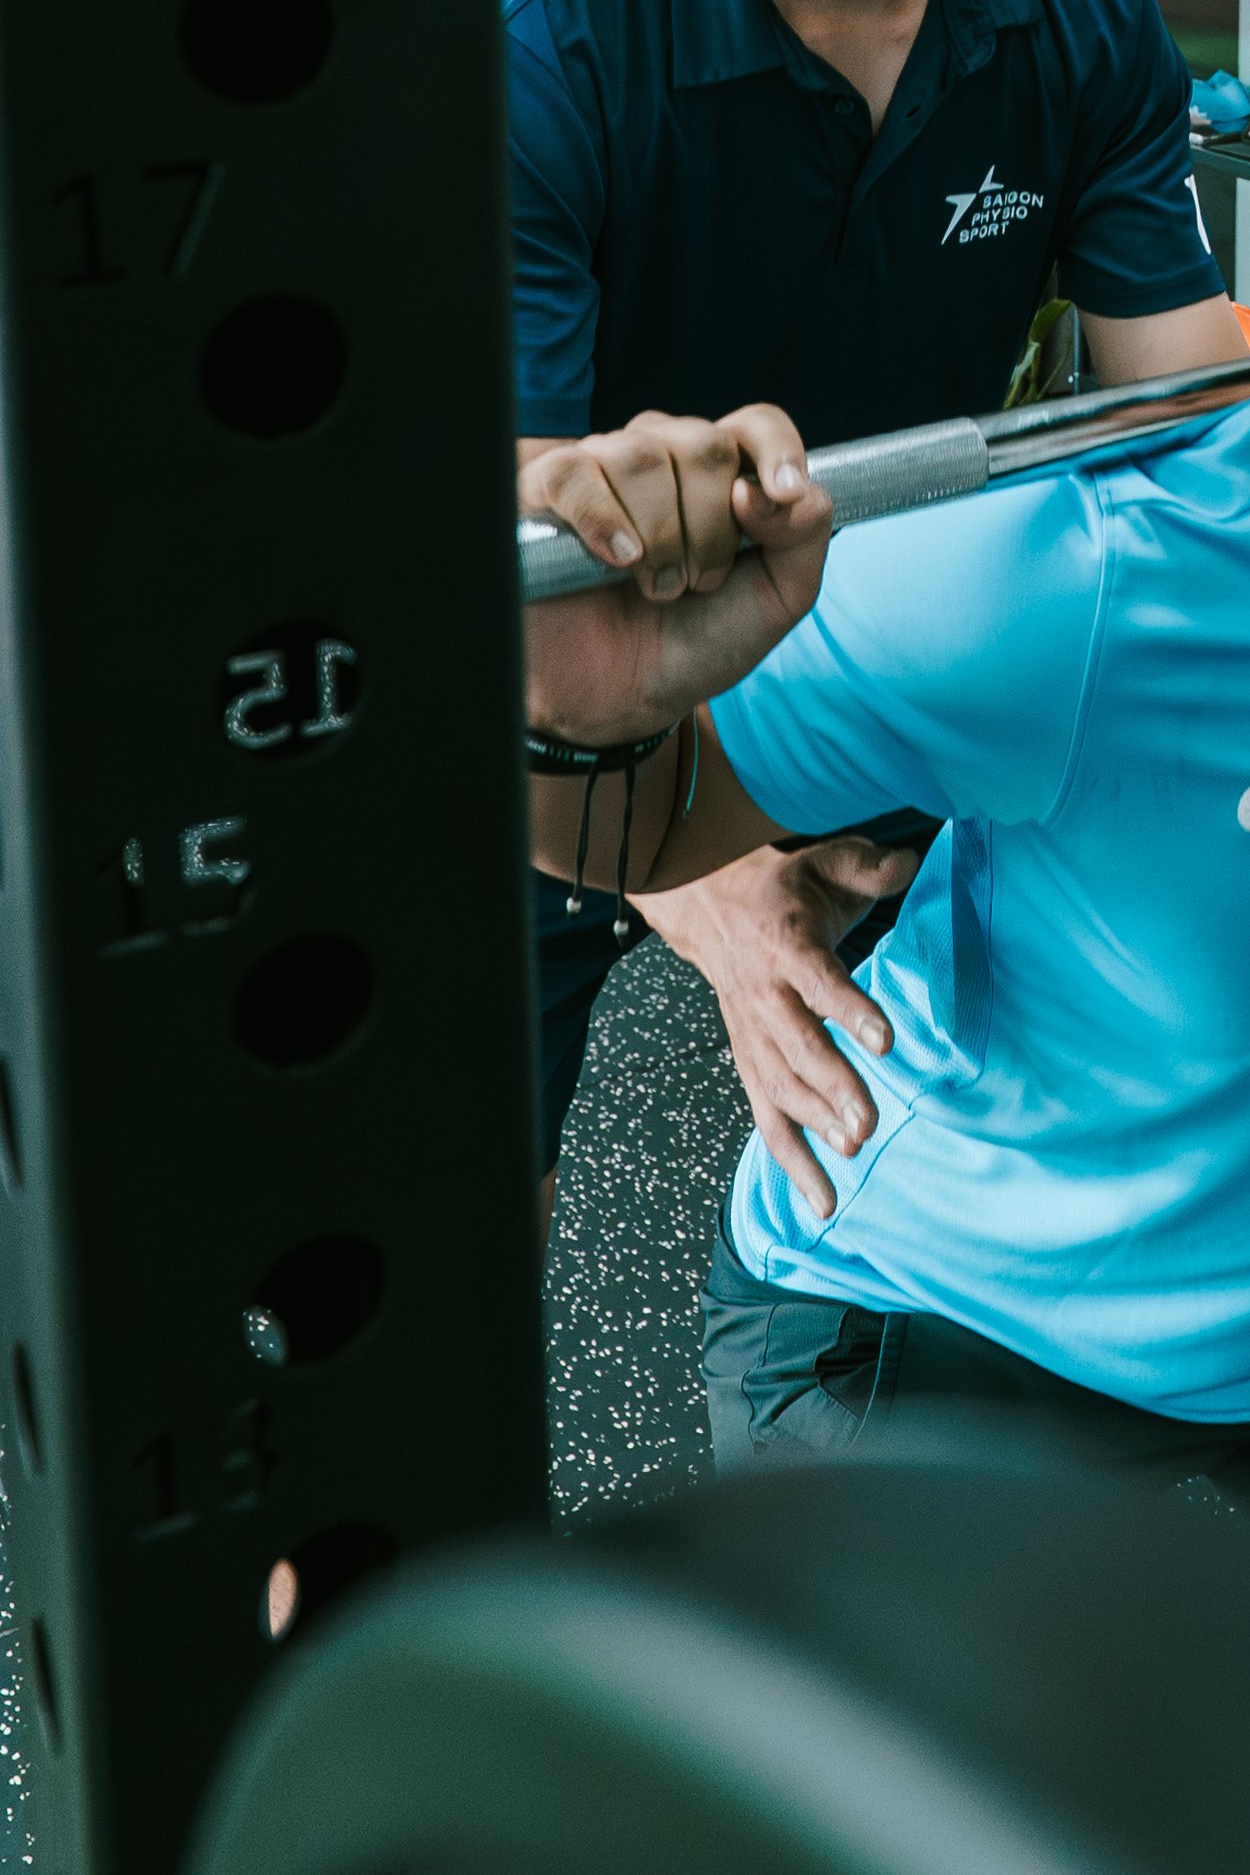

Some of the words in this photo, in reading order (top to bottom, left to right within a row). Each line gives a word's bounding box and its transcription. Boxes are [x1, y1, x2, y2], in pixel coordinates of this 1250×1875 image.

[983, 190, 1044, 209] SAIGON
[51, 159, 226, 288] 17
[971, 205, 1028, 227] PHYSIO
[959, 220, 1010, 244] SPORT
